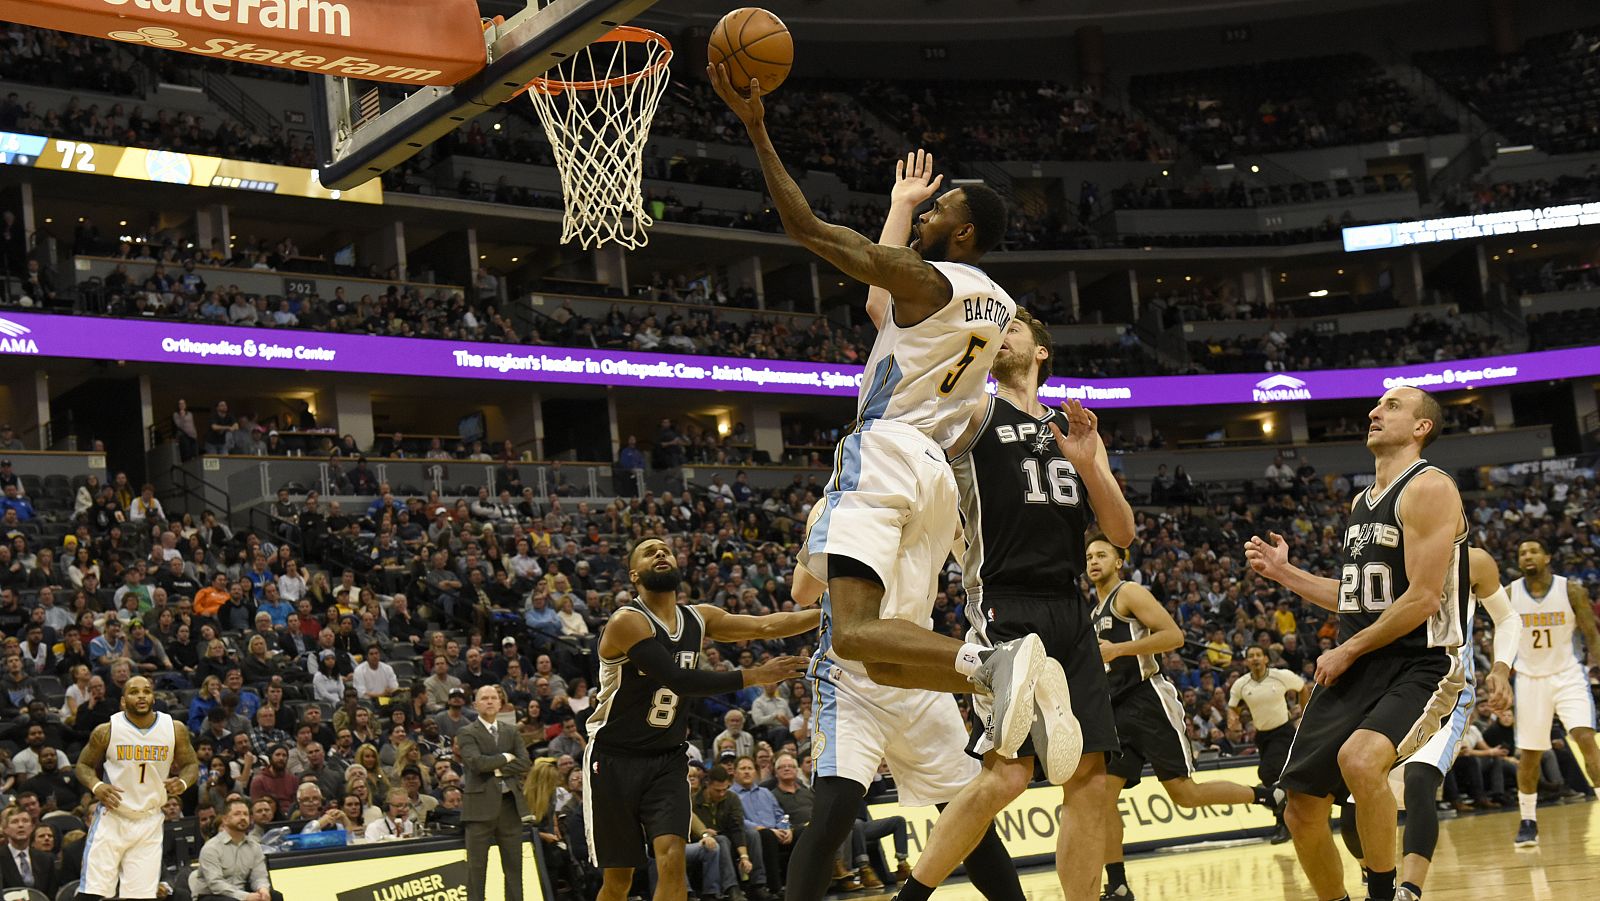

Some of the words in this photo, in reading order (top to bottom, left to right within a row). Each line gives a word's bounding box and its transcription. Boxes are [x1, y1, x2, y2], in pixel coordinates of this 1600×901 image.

[56, 140, 96, 172] 72
[963, 296, 1011, 334] BARTON
[162, 338, 242, 357] Orthopedics
[243, 340, 257, 357] &
[258, 343, 293, 360] Spine
[294, 345, 336, 361] Center
[453, 350, 483, 368] The
[484, 353, 541, 372] region's
[541, 355, 585, 373] leader
[586, 358, 600, 374] in
[600, 359, 674, 380] Orthopedic
[674, 363, 704, 380] Care
[711, 365, 743, 382] Joint
[821, 371, 854, 389] Spine
[938, 332, 989, 397] 5
[1383, 373, 1443, 390] Orthopedics
[1443, 369, 1455, 384] &
[1455, 370, 1483, 384] Spine
[1483, 366, 1518, 379] Center
[1066, 385, 1086, 399] and
[1086, 386, 1131, 400] Trauma
[1252, 388, 1312, 402] PANORAMA
[1020, 456, 1080, 507] 16
[1343, 522, 1400, 552] PURS
[1337, 562, 1395, 614] 20
[1532, 629, 1552, 649] 21
[646, 686, 680, 728] 8
[116, 744, 169, 761] NUGGETS
[138, 763, 146, 784] 1
[373, 874, 445, 901] LUMBER
